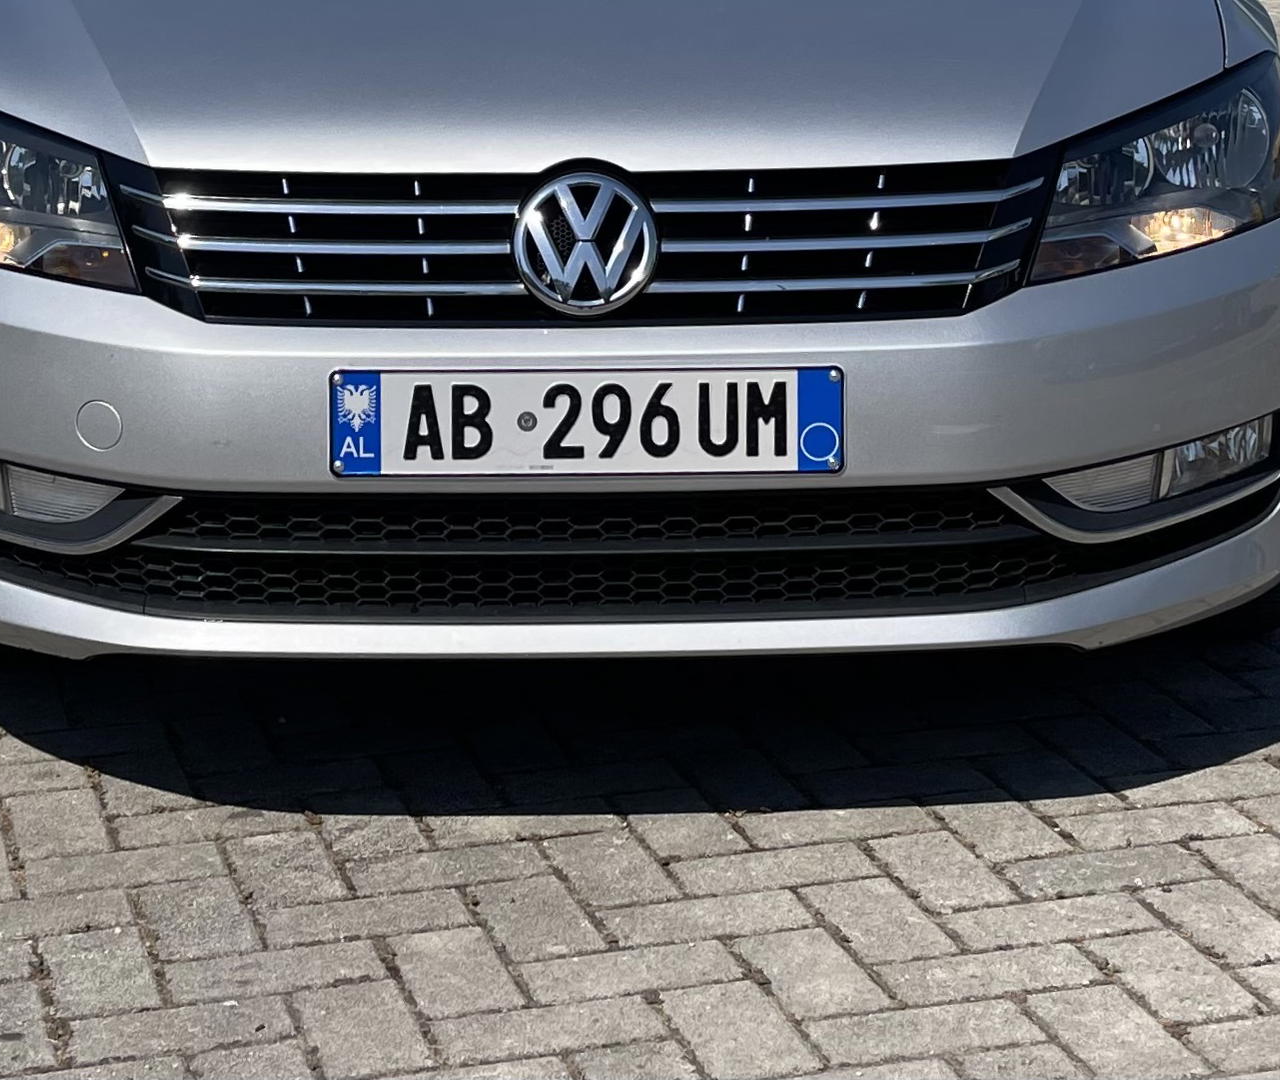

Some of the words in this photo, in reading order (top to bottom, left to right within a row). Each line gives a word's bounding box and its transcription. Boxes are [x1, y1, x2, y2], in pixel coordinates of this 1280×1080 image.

[519, 176, 654, 310] VW
[339, 436, 375, 458] AL
[402, 384, 493, 460] AB
[542, 383, 681, 460] 296
[697, 381, 787, 458] UM
